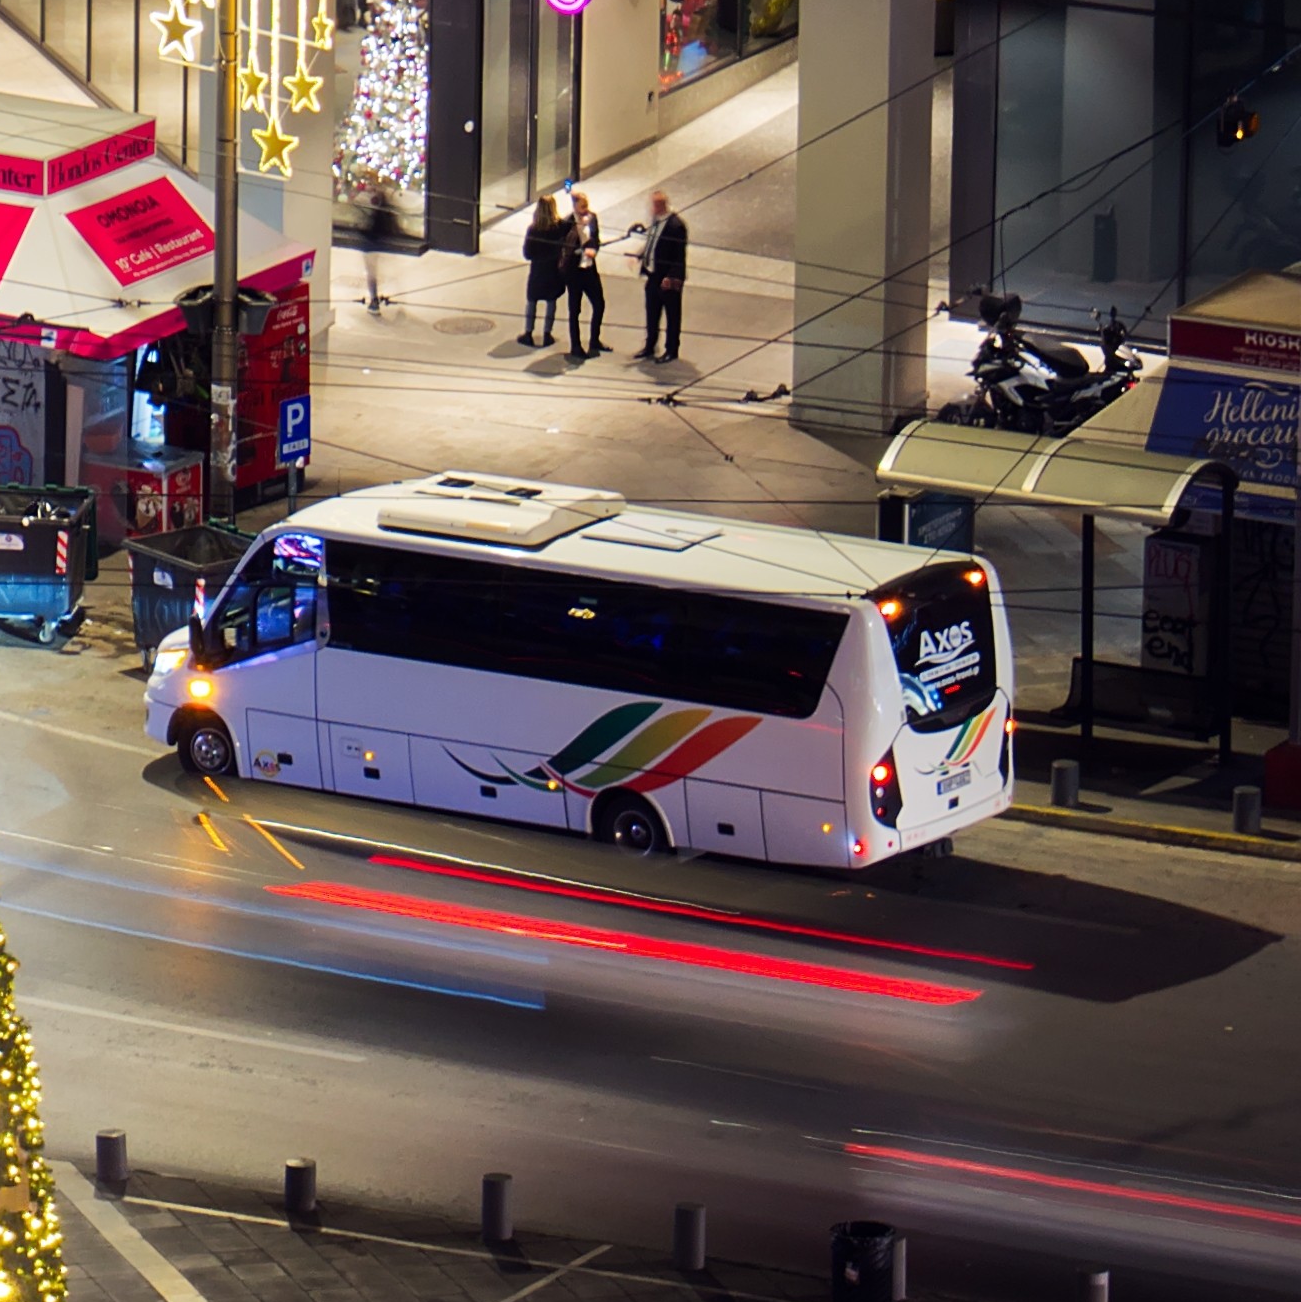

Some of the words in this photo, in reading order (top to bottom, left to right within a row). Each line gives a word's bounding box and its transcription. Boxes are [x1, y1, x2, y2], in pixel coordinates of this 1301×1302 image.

[50, 150, 102, 189] Hondos
[104, 136, 151, 167] Center
[97, 194, 160, 228] OMONOIA
[130, 245, 153, 266] Café
[154, 228, 205, 255] Restaurant
[1244, 330, 1300, 351] KIOSK
[287, 402, 305, 439] P
